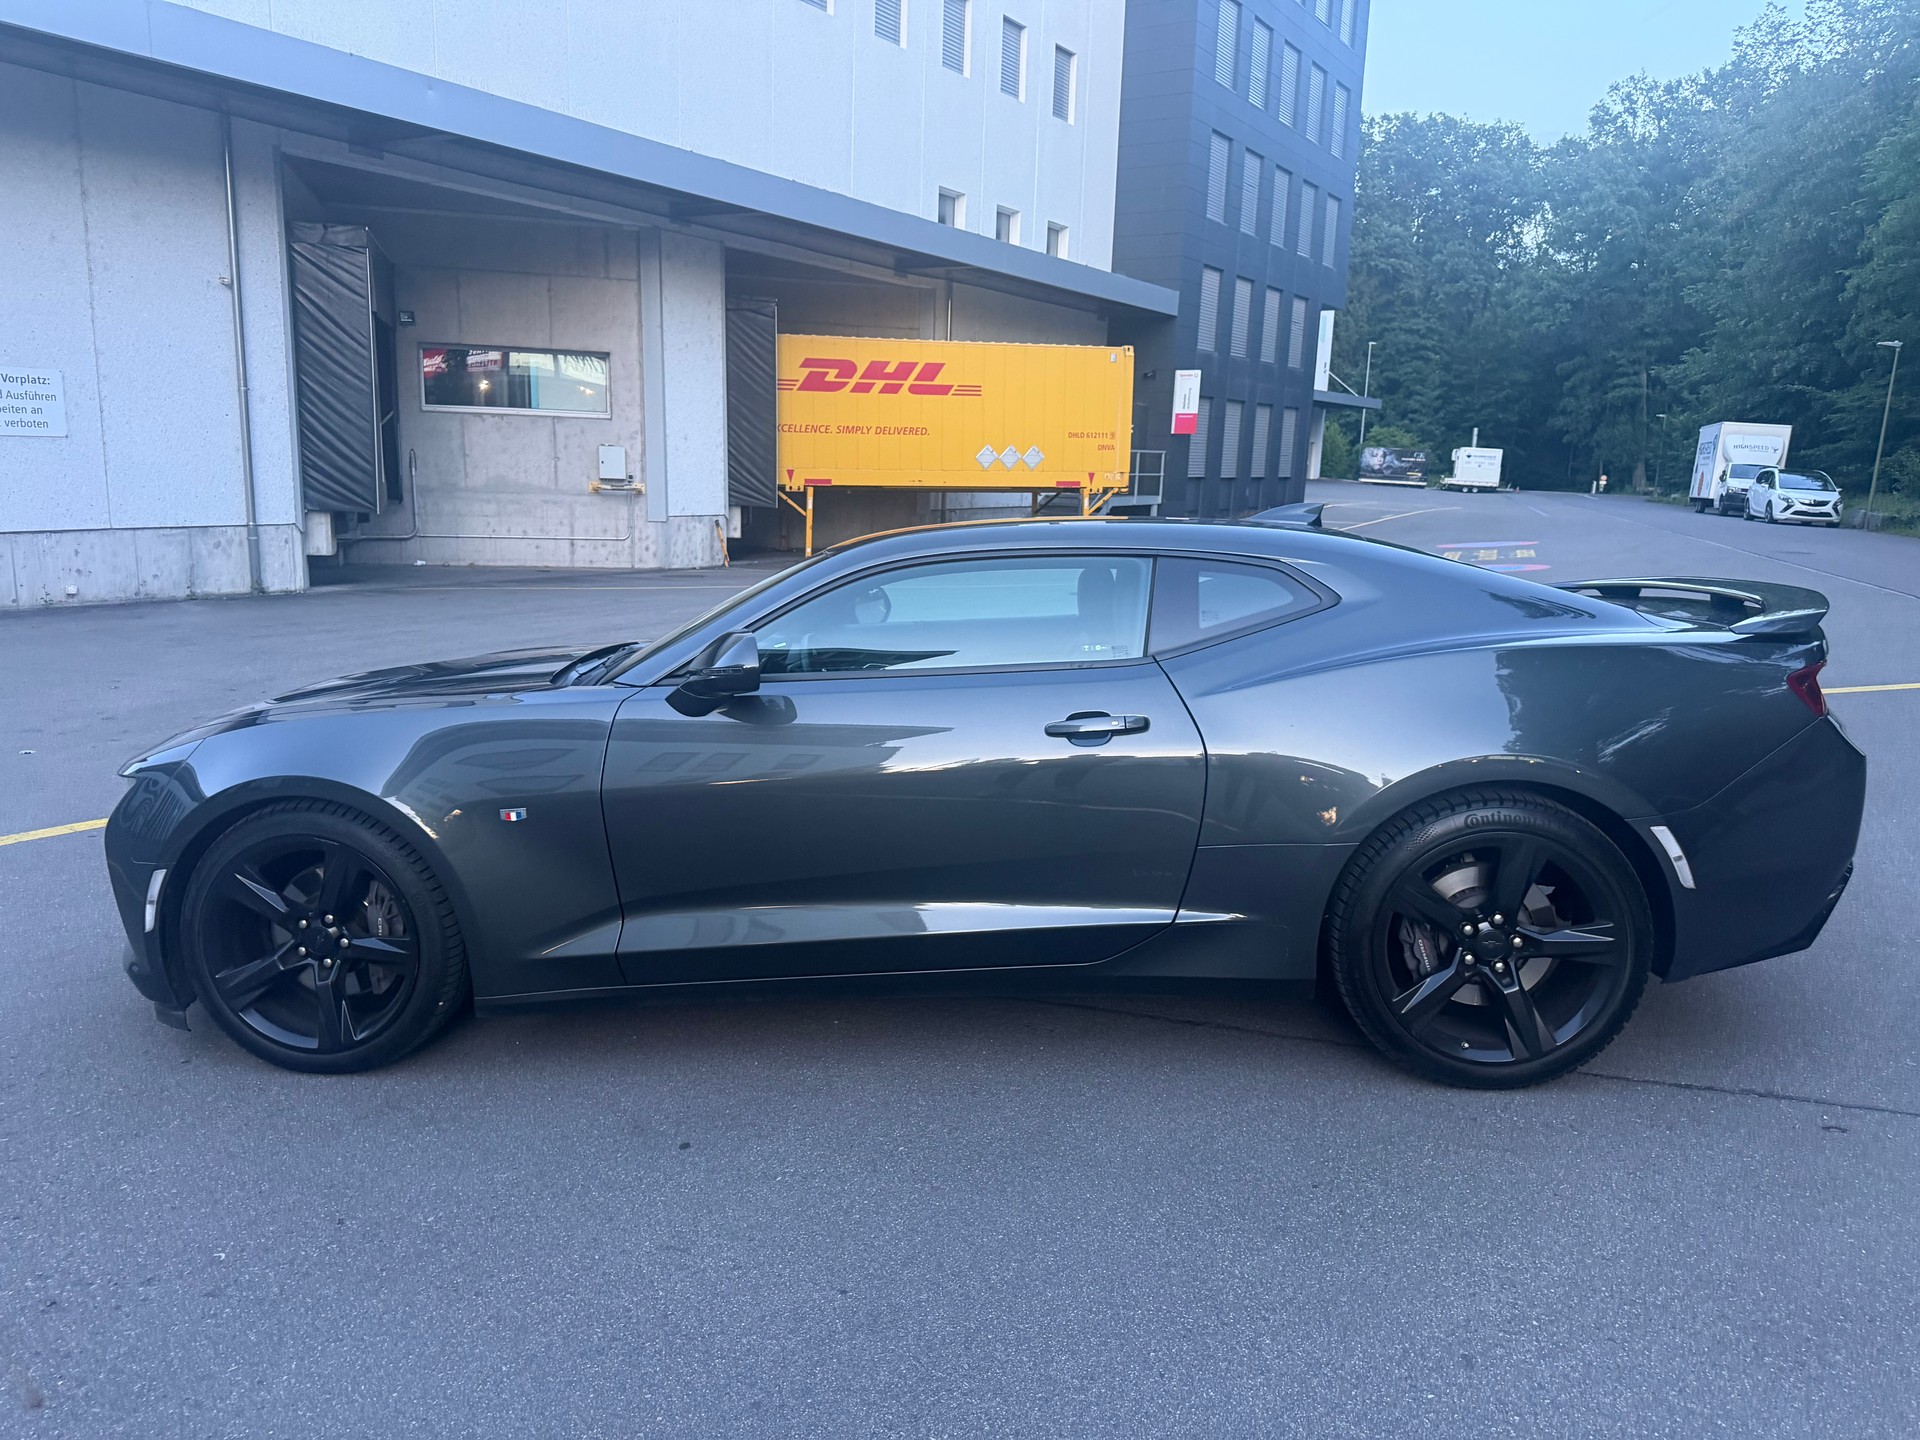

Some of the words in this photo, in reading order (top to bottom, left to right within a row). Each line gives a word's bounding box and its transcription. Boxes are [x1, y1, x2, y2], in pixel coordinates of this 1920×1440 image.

[0, 373, 50, 386] Vorplatz:
[796, 357, 955, 396] DHL
[5, 390, 57, 401] Ausführen
[0, 404, 27, 414] eiten
[4, 418, 49, 429] verboten
[836, 424, 873, 435] SIMPLY
[875, 425, 931, 436] DELIVERED.
[1086, 431, 1108, 439] 612111
